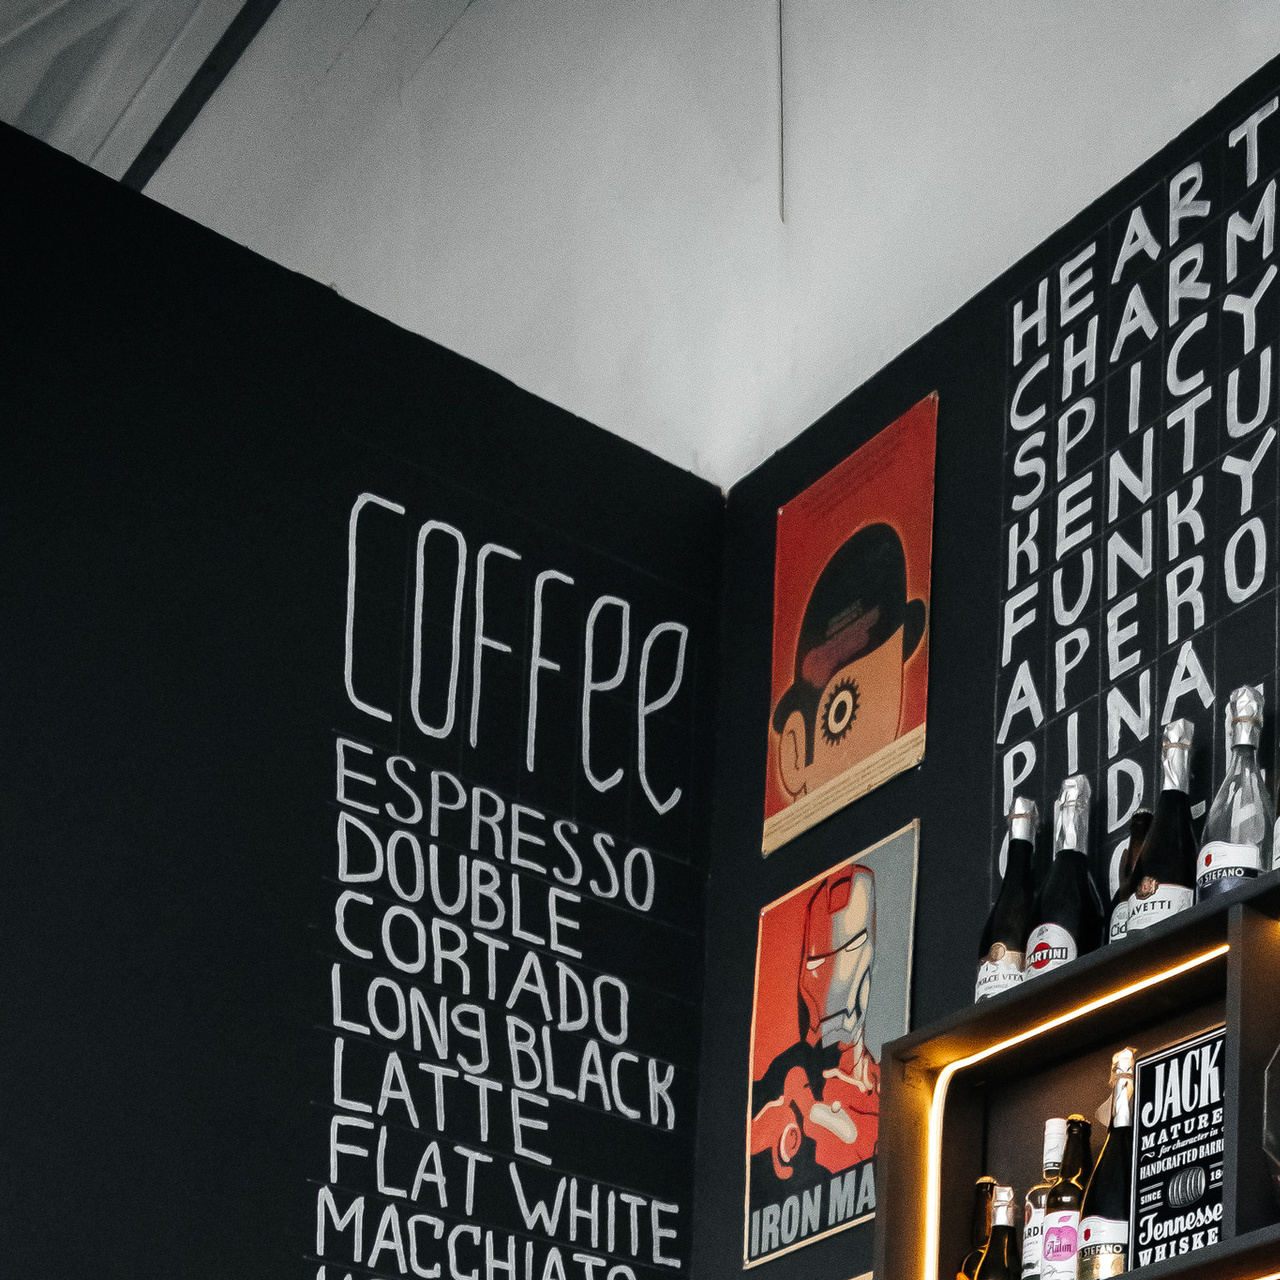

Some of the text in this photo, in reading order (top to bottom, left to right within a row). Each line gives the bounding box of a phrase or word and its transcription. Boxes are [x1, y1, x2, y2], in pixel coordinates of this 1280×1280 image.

[1010, 265, 1278, 511] SPICY
[1002, 427, 1277, 667] FUNKY
[1003, 640, 1216, 816] PINA
[336, 736, 657, 913] ESPRESSO
[337, 810, 583, 958] DOUBLE
[1204, 867, 1245, 883] STEFANO
[335, 889, 630, 1045] CORTADO
[333, 1037, 552, 1165] LATTE
[505, 1014, 675, 1130] BLACK
[1141, 1039, 1223, 1128] JACK
[1140, 1147, 1198, 1180] HANDCRAFTED
[1141, 1107, 1223, 1151] MATURE
[1157, 1127, 1219, 1158] for character in
[329, 1115, 682, 1268] FLAT WHITE
[751, 1184, 821, 1258] IRON
[1138, 1202, 1223, 1246] Tennesse
[1140, 1189, 1162, 1205] SINCE
[1083, 1243, 1123, 1258] STEFANO
[1138, 1226, 1219, 1268] WHISKE
